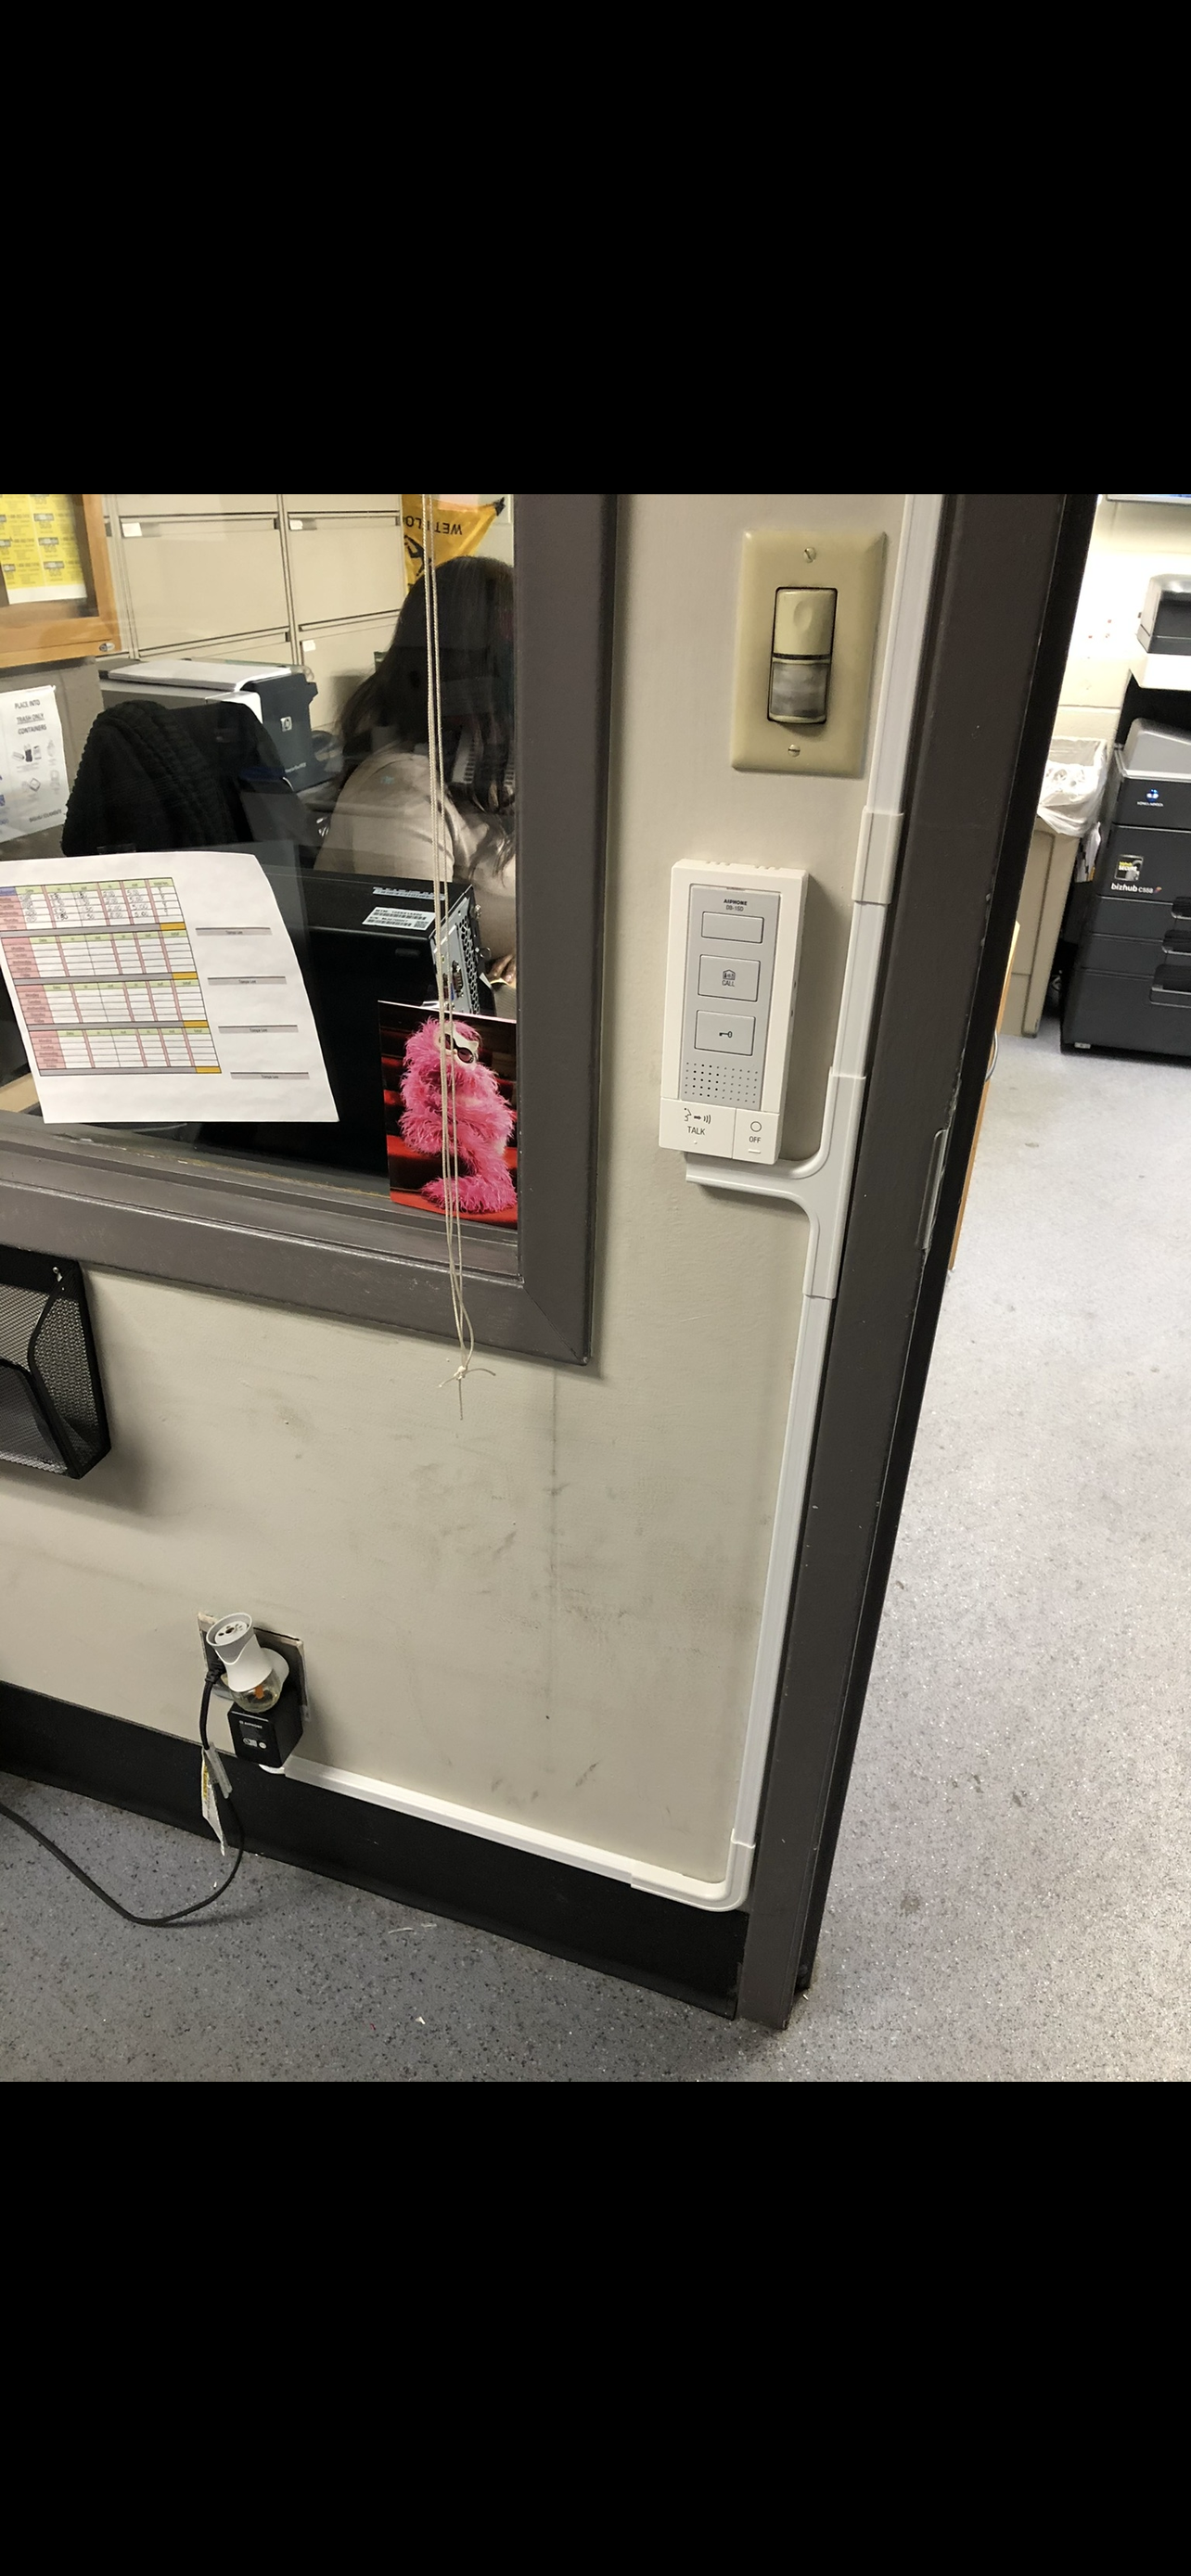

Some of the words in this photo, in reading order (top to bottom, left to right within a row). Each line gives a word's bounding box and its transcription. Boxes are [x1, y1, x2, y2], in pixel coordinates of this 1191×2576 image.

[434, 522, 462, 535] WET
[15, 701, 29, 709] PLACE
[18, 724, 47, 734] CONTAINERS
[1111, 883, 1137, 892] bizhub
[722, 979, 735, 988] CALL
[687, 1126, 706, 1136] TALK
